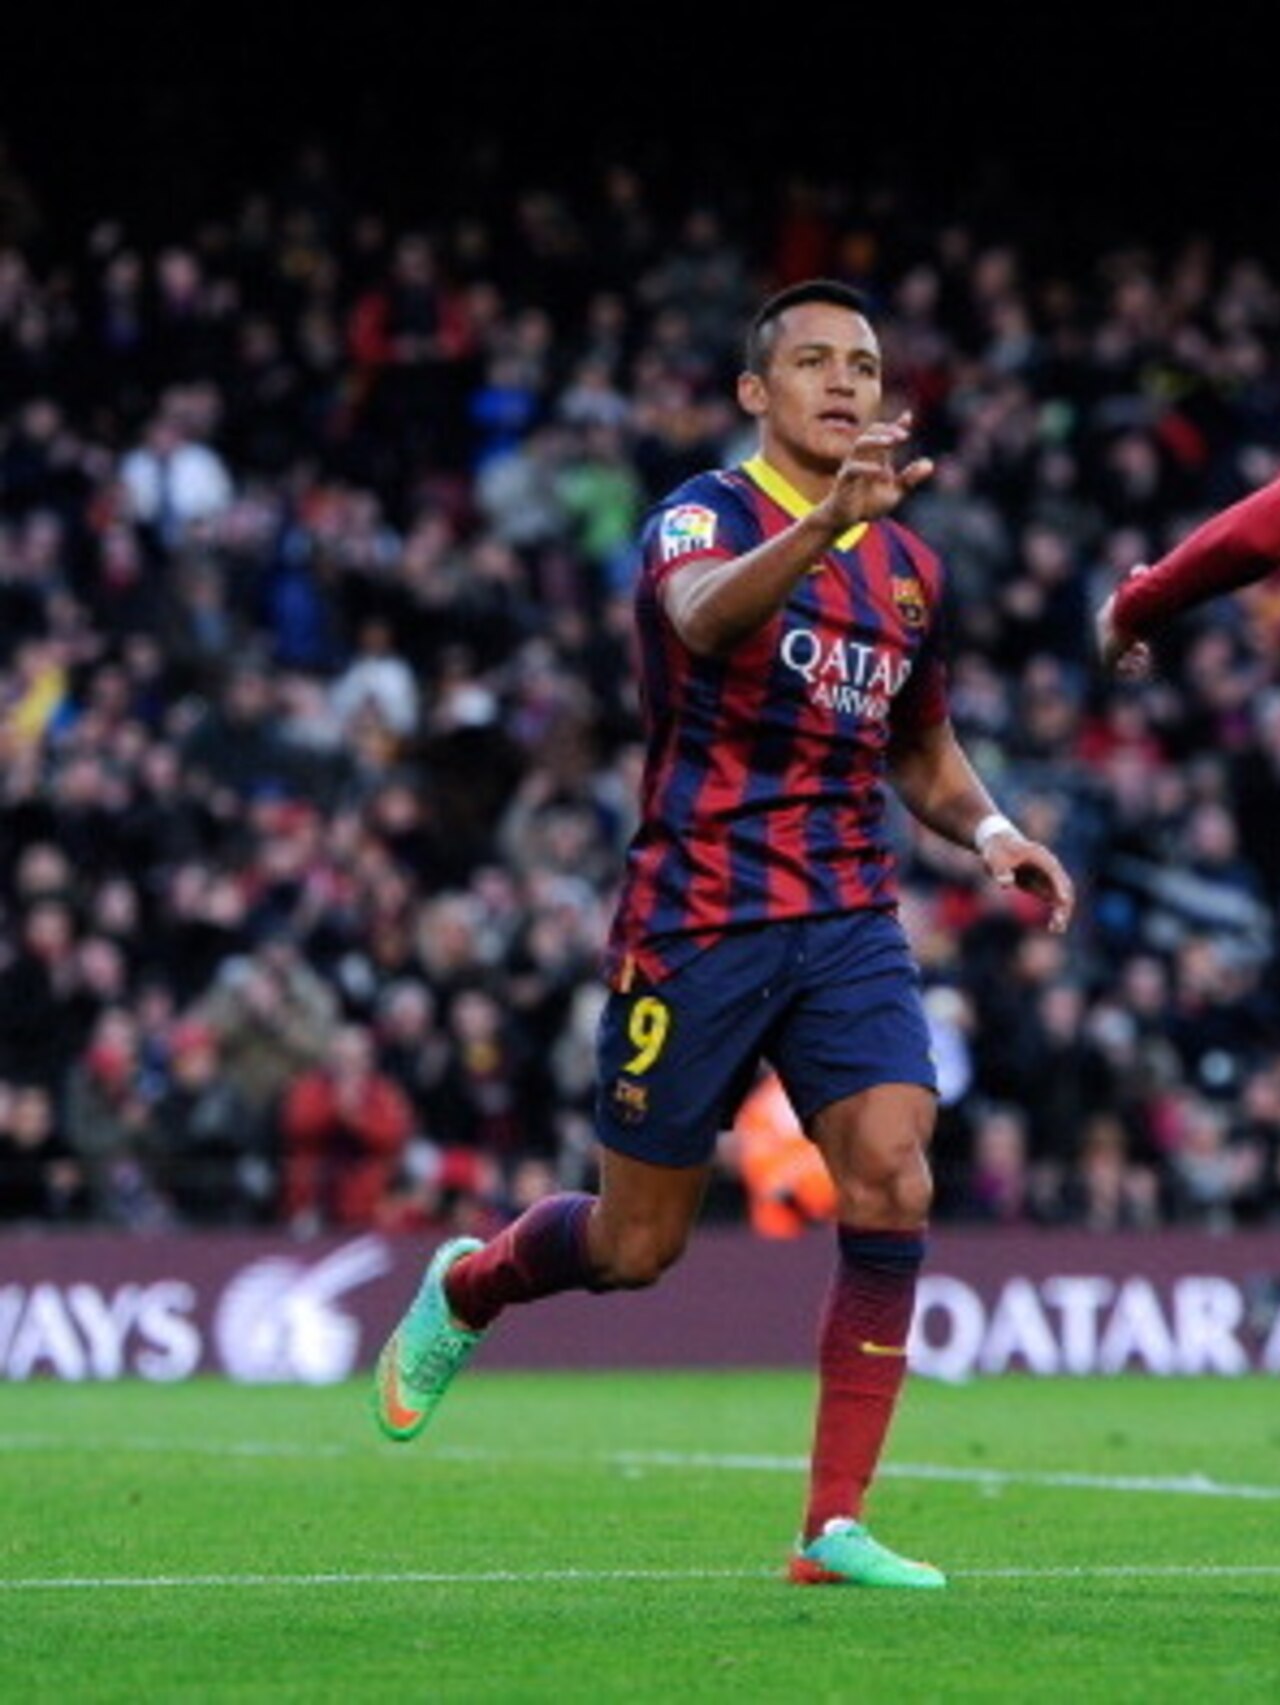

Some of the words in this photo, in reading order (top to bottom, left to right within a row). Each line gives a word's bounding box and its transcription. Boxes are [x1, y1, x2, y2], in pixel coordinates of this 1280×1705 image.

[623, 996, 670, 1076] 9
[0, 1281, 202, 1383] AYS
[907, 1276, 1249, 1384] QATAR
